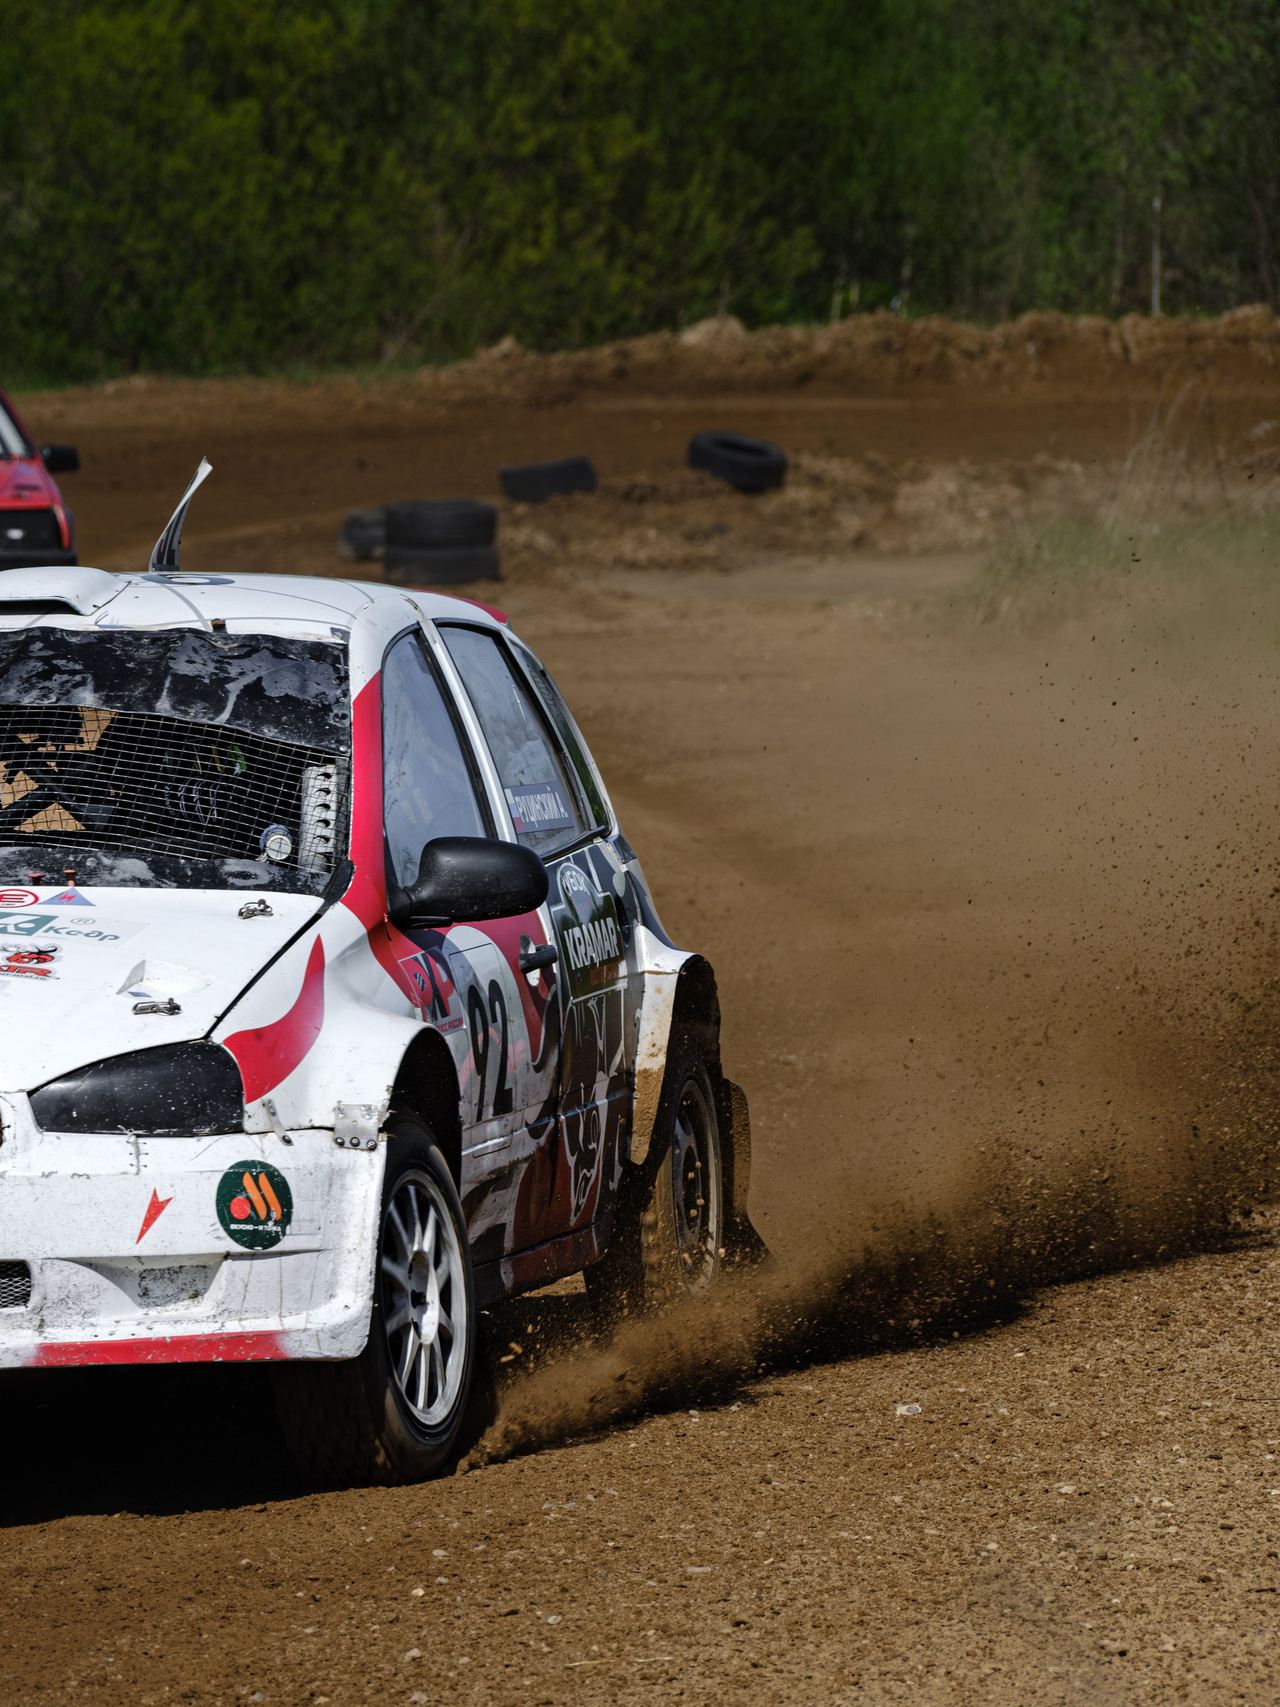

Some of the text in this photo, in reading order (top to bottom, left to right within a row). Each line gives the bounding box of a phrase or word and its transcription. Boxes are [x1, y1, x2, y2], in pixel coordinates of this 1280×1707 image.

[41, 925, 120, 941] Кедр
[563, 917, 620, 970] KRAMAR
[467, 978, 514, 1123] 92
